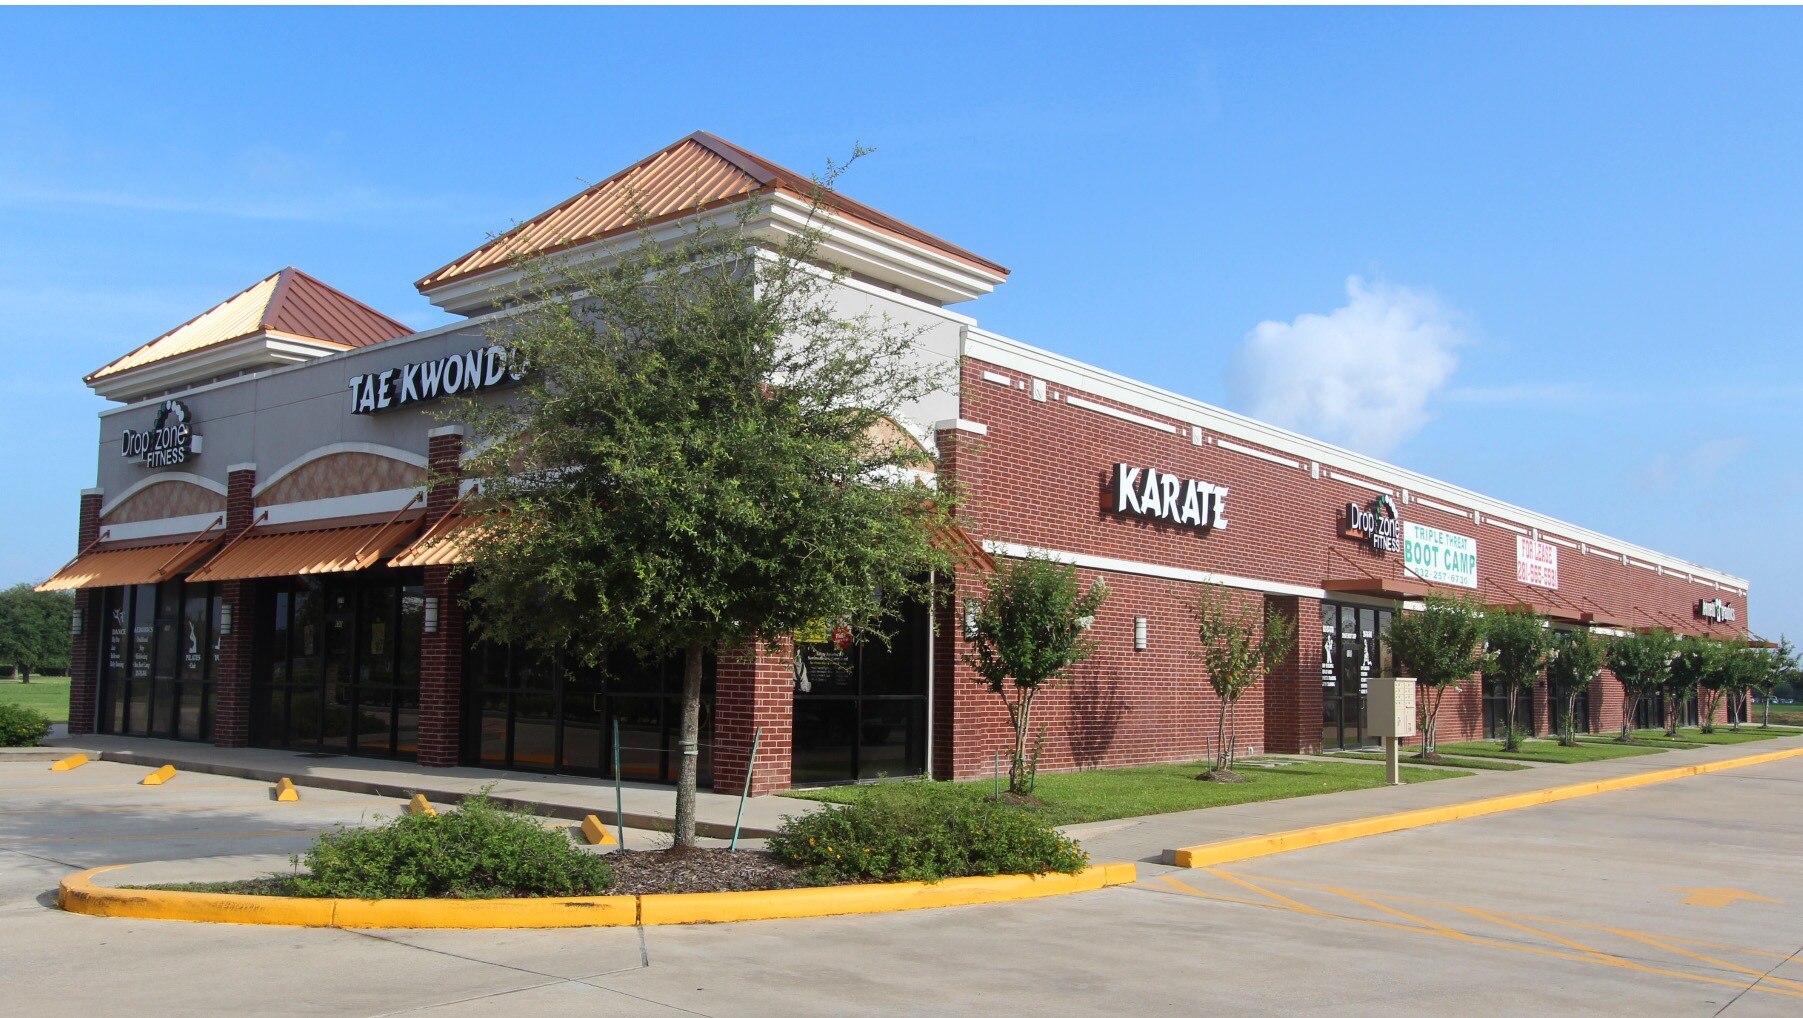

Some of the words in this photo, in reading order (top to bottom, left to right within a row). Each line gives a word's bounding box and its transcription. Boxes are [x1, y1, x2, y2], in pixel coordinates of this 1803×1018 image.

[349, 369, 394, 414] TAE
[121, 429, 150, 460] Drop
[155, 424, 186, 451] zone
[147, 447, 185, 468] FITNESS
[1118, 463, 1230, 530] KARATE
[1351, 503, 1374, 538] Drop
[1378, 517, 1400, 538] zone
[1373, 534, 1400, 552] FITNESS
[1414, 526, 1443, 545] TRIPLE
[1446, 533, 1468, 551] THREAT
[1521, 538, 1534, 559] FOR
[1534, 541, 1553, 565] LEASE
[1405, 540, 1439, 568] BOOT
[1444, 548, 1475, 575] CAMP
